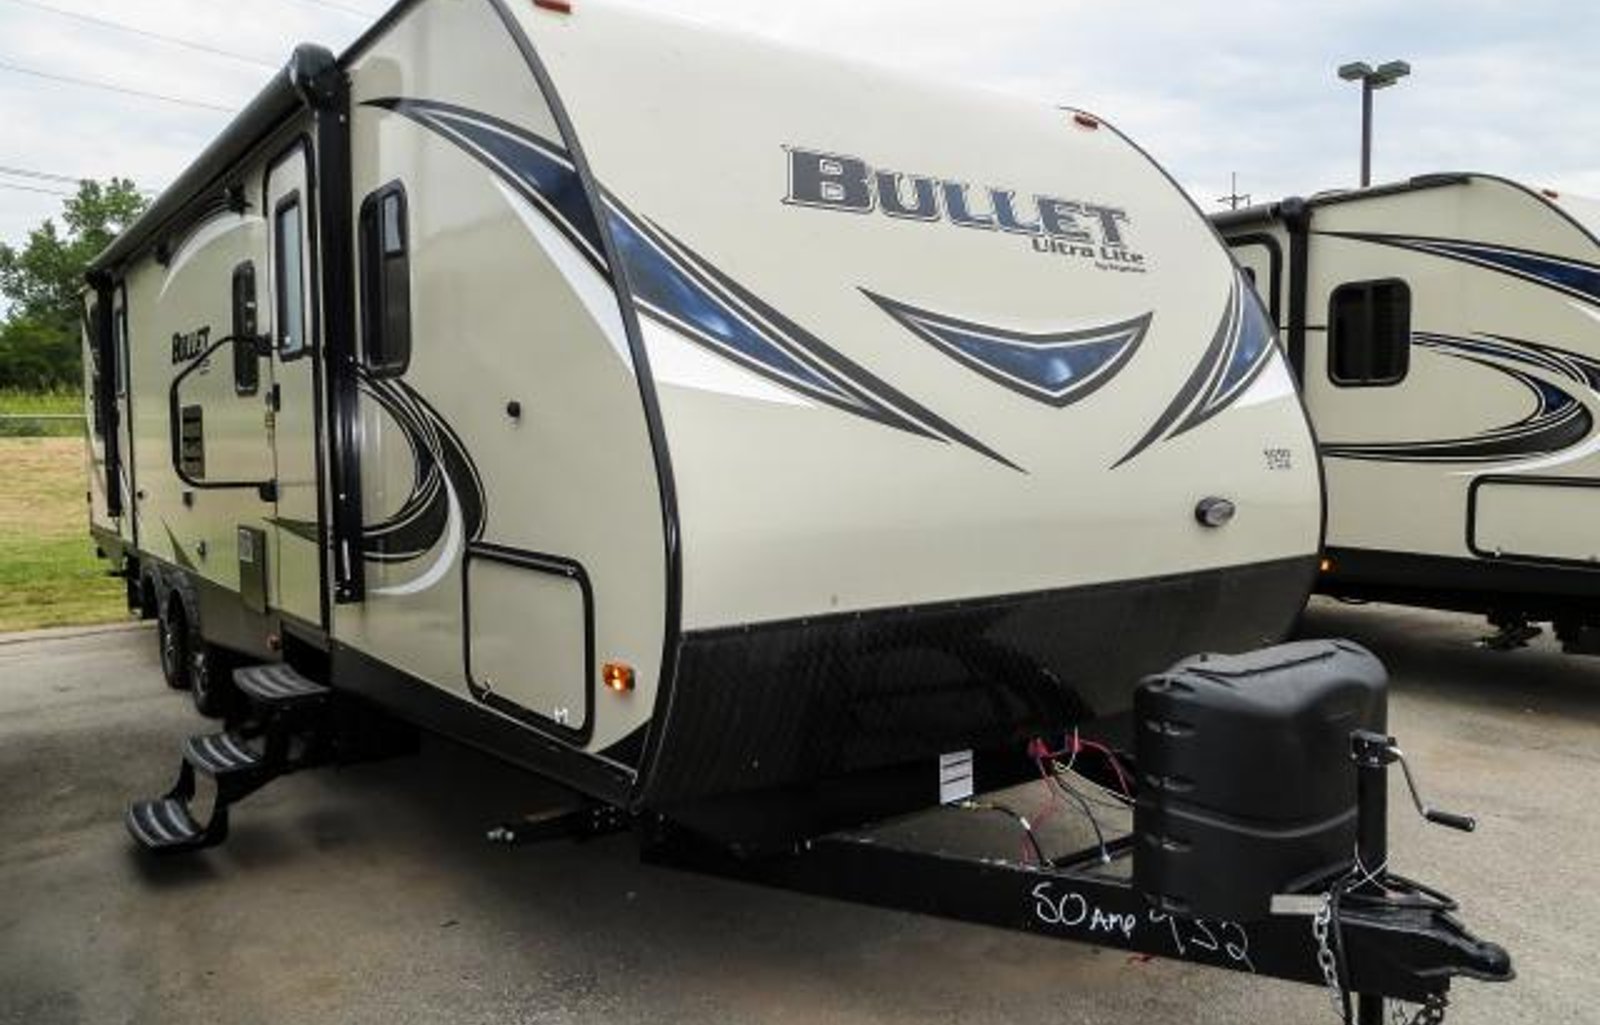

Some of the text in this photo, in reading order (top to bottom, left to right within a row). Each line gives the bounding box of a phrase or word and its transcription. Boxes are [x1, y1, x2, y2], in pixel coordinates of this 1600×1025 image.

[780, 143, 1131, 246] BULLET
[1032, 237, 1146, 265] Ultra Lite
[172, 325, 211, 365] BULLET
